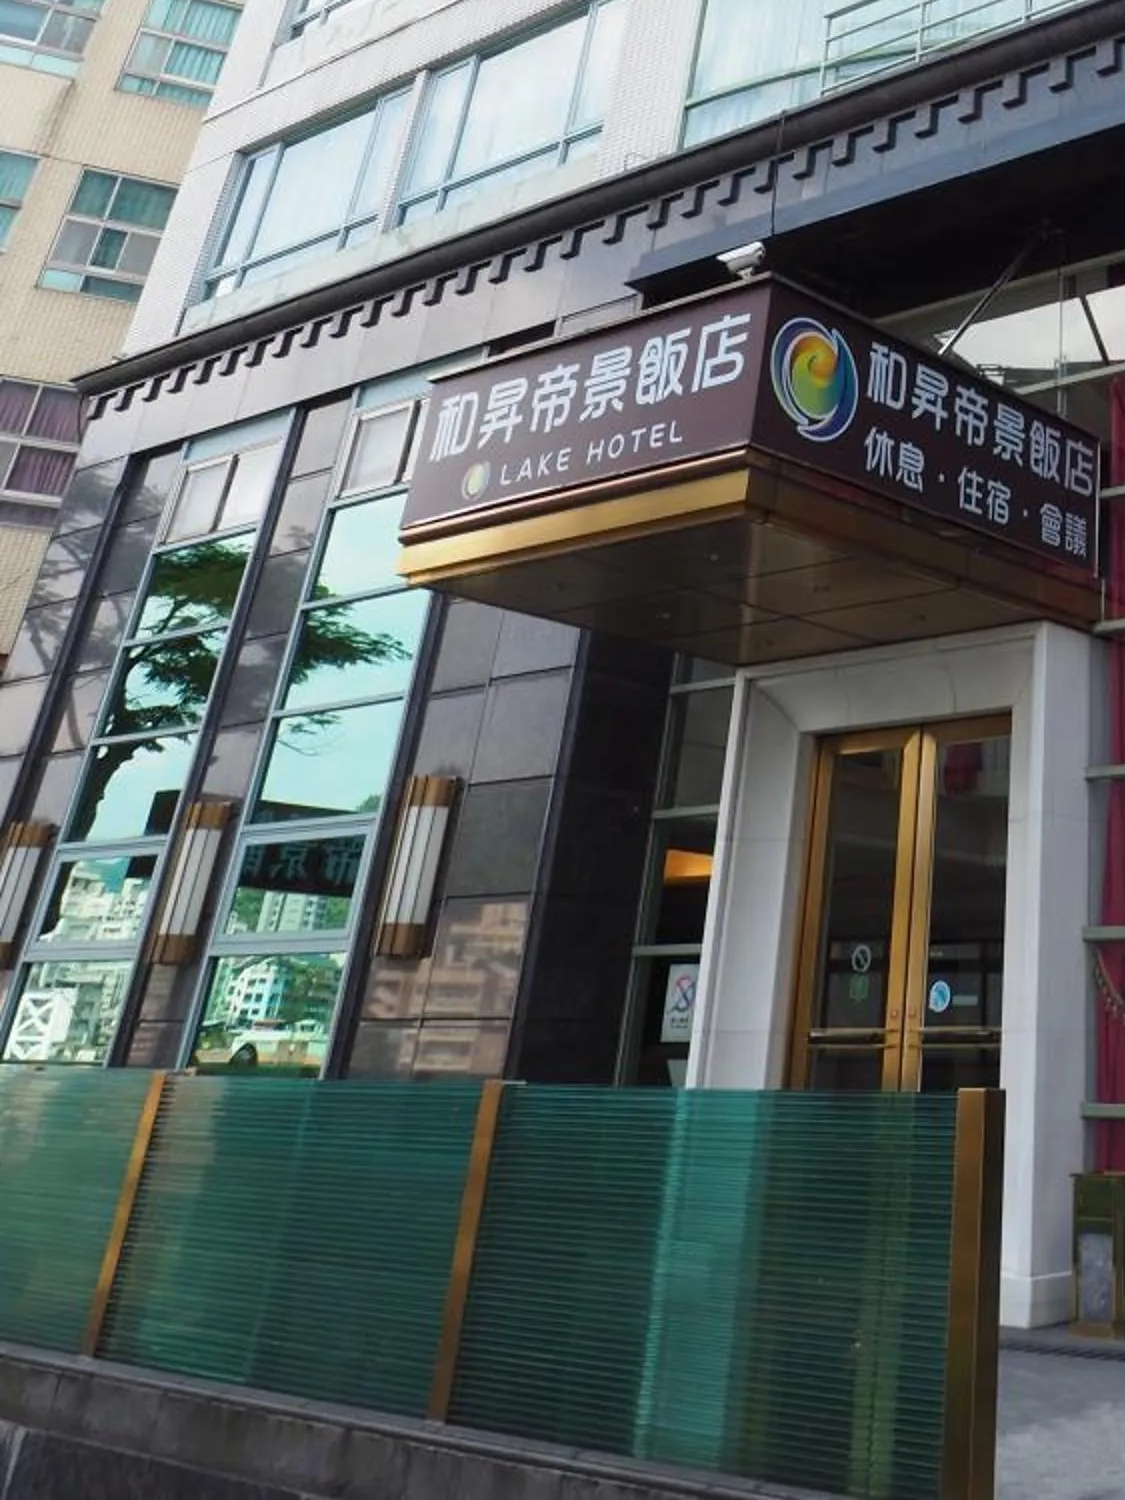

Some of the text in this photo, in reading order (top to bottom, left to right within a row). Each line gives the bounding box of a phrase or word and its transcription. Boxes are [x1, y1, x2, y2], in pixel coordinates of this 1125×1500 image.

[430, 313, 751, 462] 和昇帝景飯店
[501, 420, 683, 486] LAKE HOTEL
[867, 341, 1095, 497] 和昇帝景飯店
[865, 426, 1087, 558] 休息 住宿 會議
